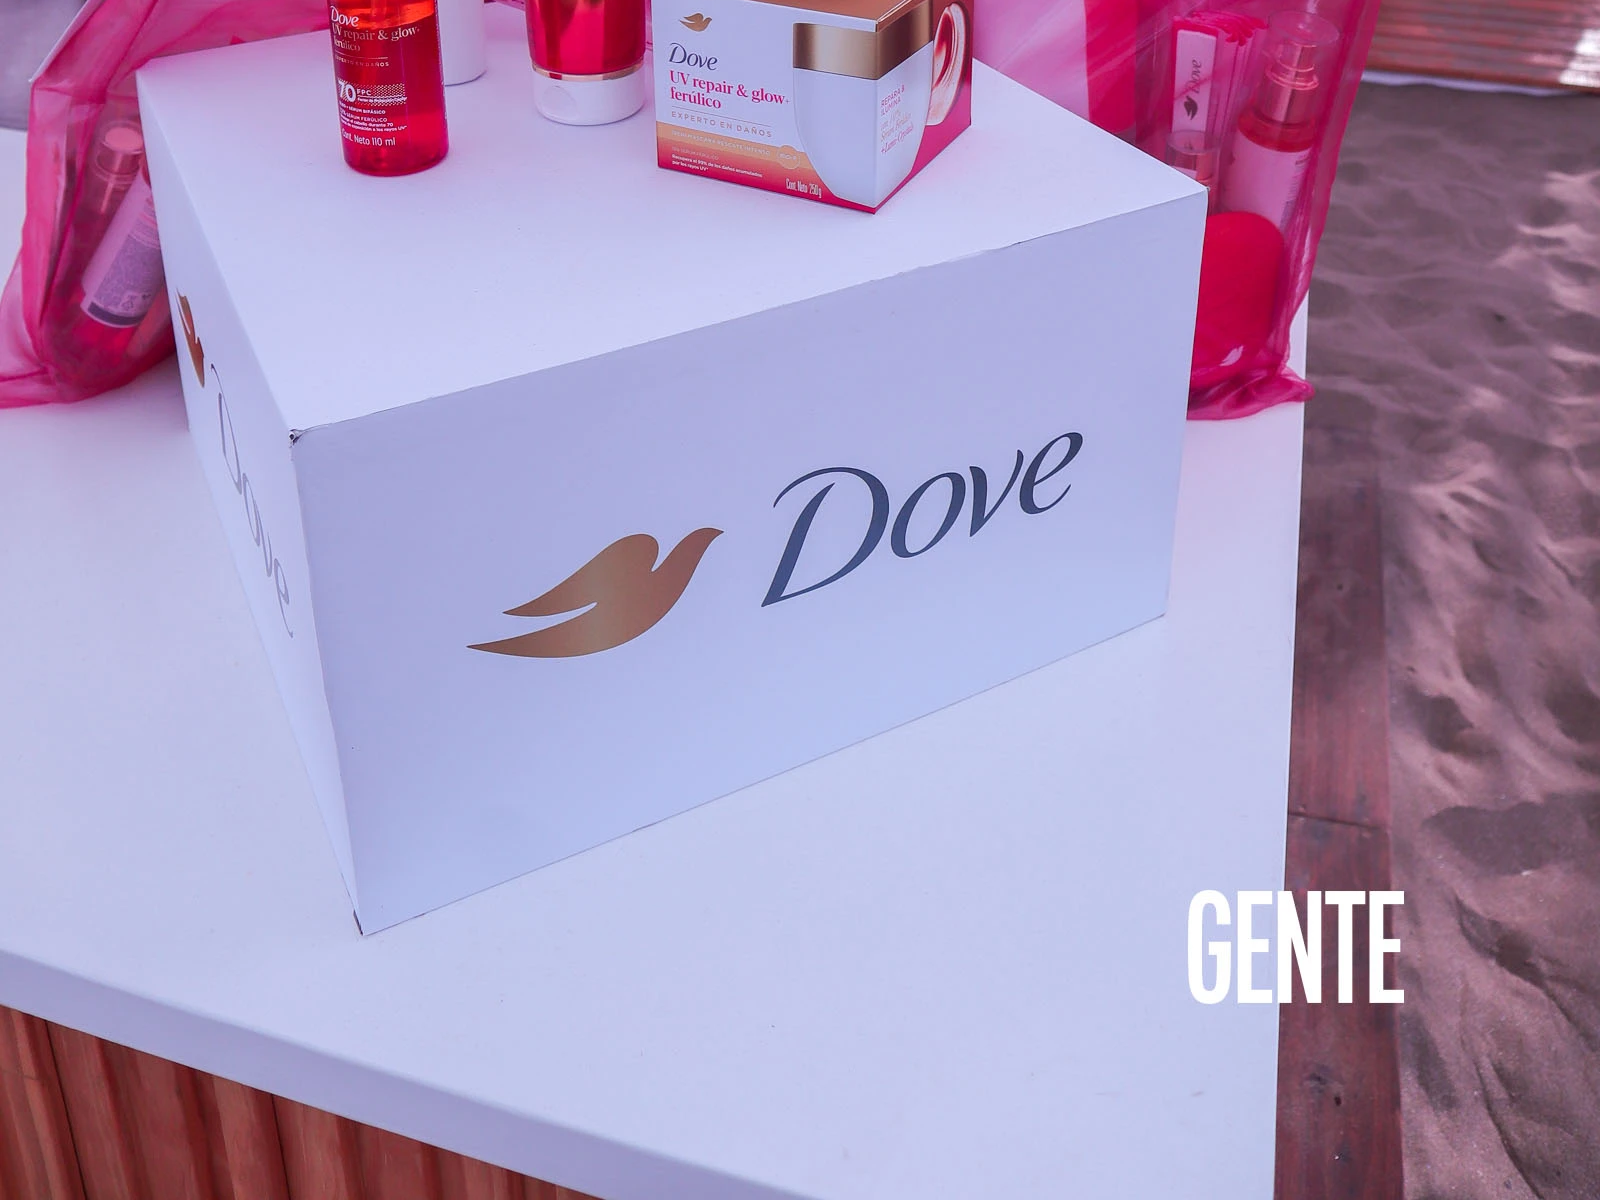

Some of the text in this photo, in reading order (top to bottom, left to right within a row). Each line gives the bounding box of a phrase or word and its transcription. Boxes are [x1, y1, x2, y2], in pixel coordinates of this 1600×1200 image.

[330, 5, 359, 27] Dove
[343, 30, 376, 41] repair
[377, 29, 389, 41] &
[668, 42, 718, 71] Dove
[669, 69, 691, 86] UV
[692, 77, 734, 94] repair
[736, 83, 749, 98] &
[1185, 59, 1202, 94] Dove
[338, 79, 357, 102] 70
[356, 88, 372, 96] FPC
[670, 86, 722, 109] ferúlico
[671, 110, 772, 138] EXPERTO EN DAÑOS
[353, 134, 371, 146] Neto
[371, 137, 383, 147] 110
[384, 137, 396, 146] ml
[797, 180, 808, 193] Neto
[210, 362, 294, 639] Dove
[761, 431, 1084, 608] Dove
